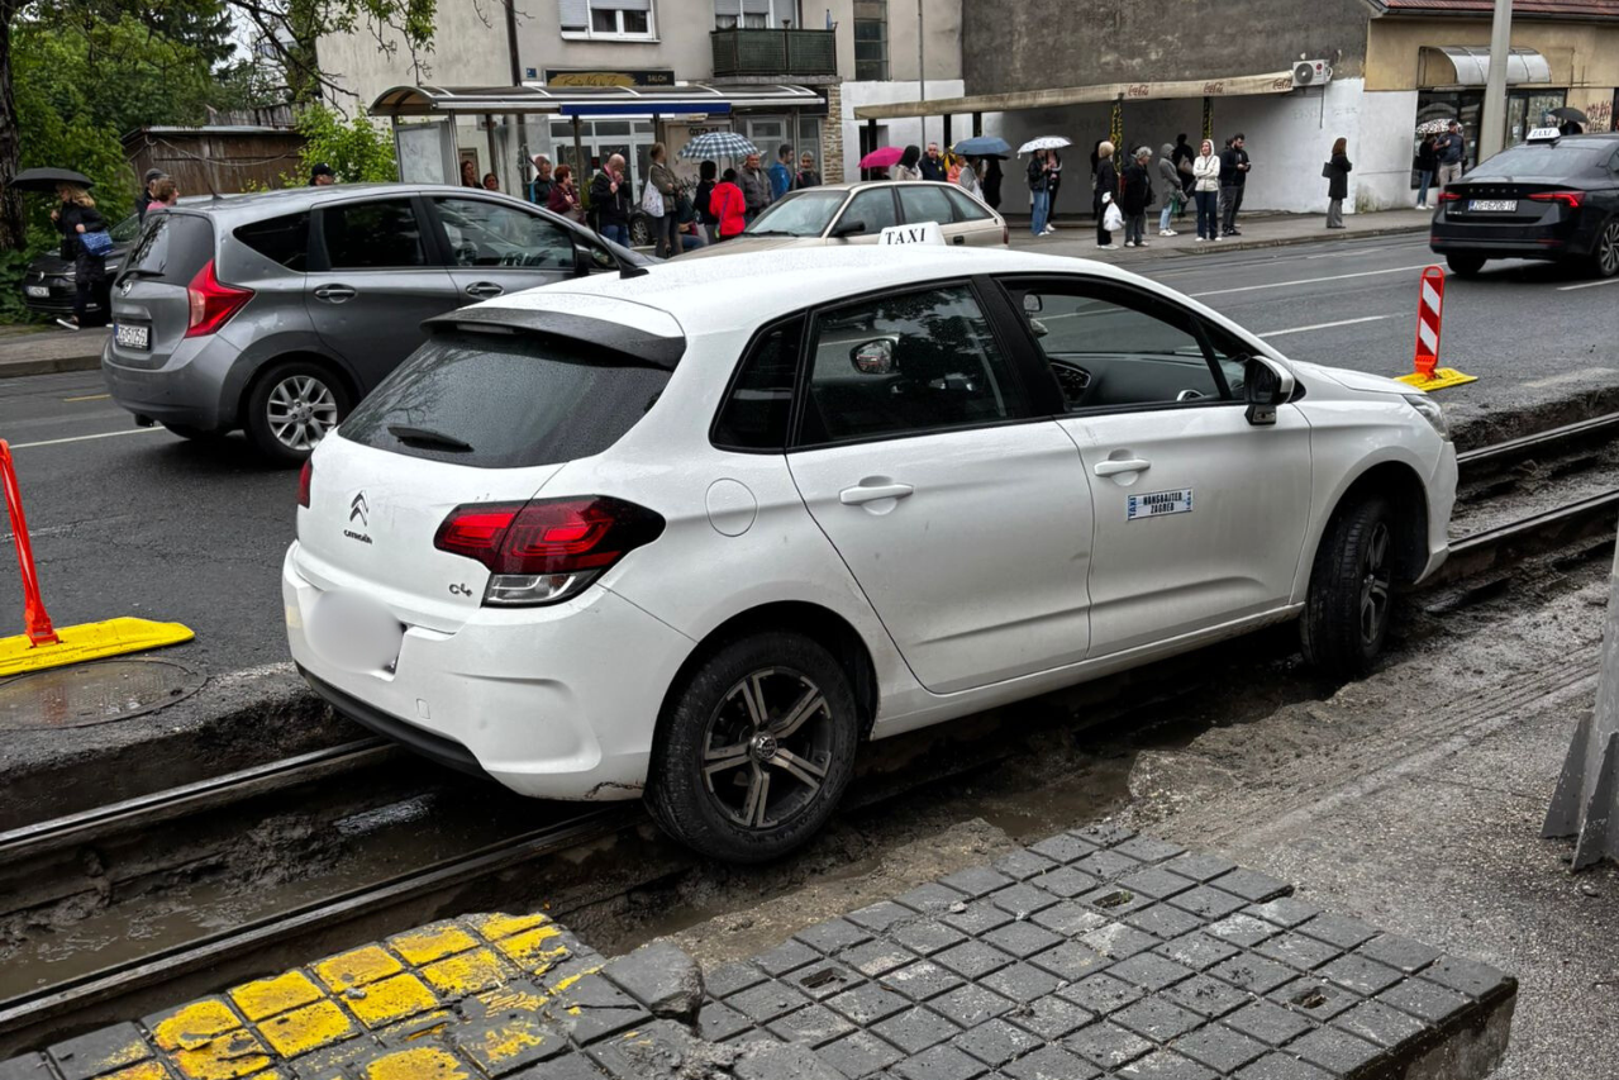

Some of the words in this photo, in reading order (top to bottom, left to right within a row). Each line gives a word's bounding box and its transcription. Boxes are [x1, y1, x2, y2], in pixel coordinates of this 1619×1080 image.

[1532, 129, 1553, 138] TAXI
[885, 227, 926, 245] TAXI
[1128, 497, 1137, 517] TAXI
[1150, 502, 1175, 514] ZAGREB
[448, 582, 473, 598] C4
